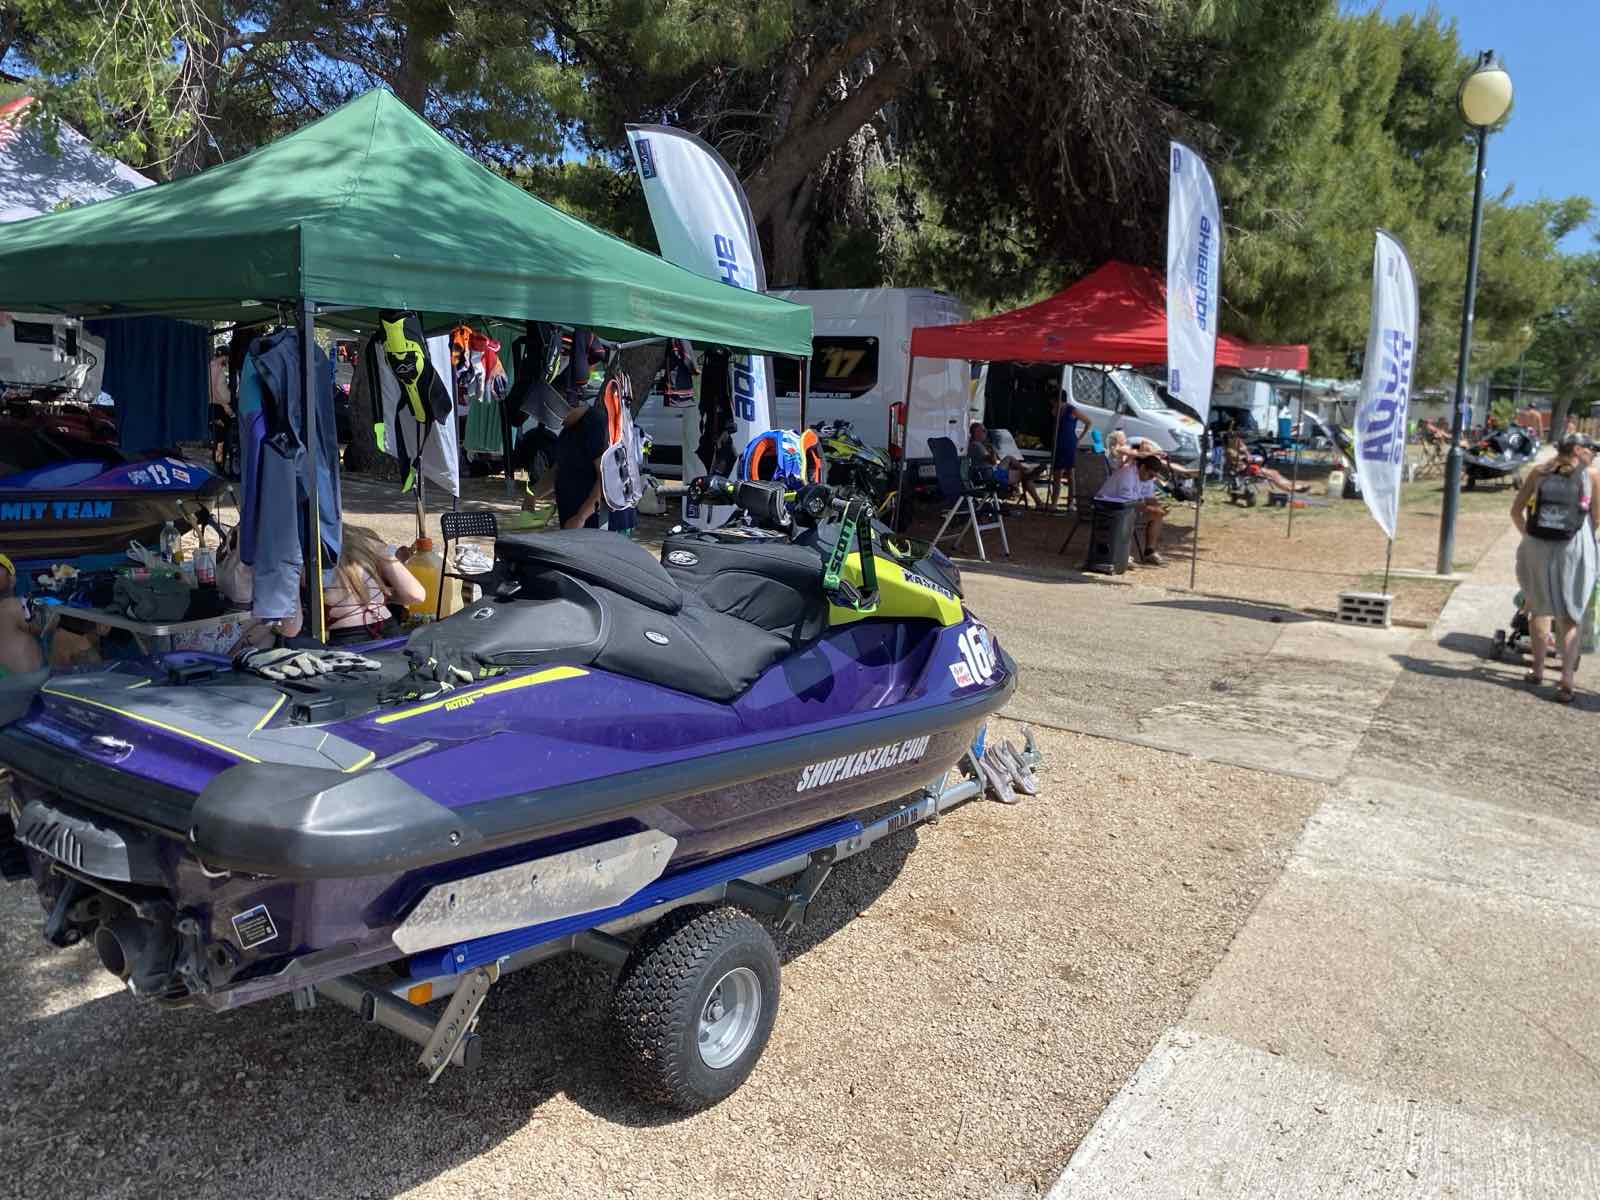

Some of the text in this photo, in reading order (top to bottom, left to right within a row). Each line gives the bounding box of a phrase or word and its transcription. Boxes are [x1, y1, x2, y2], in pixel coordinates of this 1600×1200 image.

[1359, 329, 1399, 461] AQUA
[147, 464, 170, 485] 13
[51, 501, 112, 520] TEAM
[444, 696, 475, 711] ROTAX
